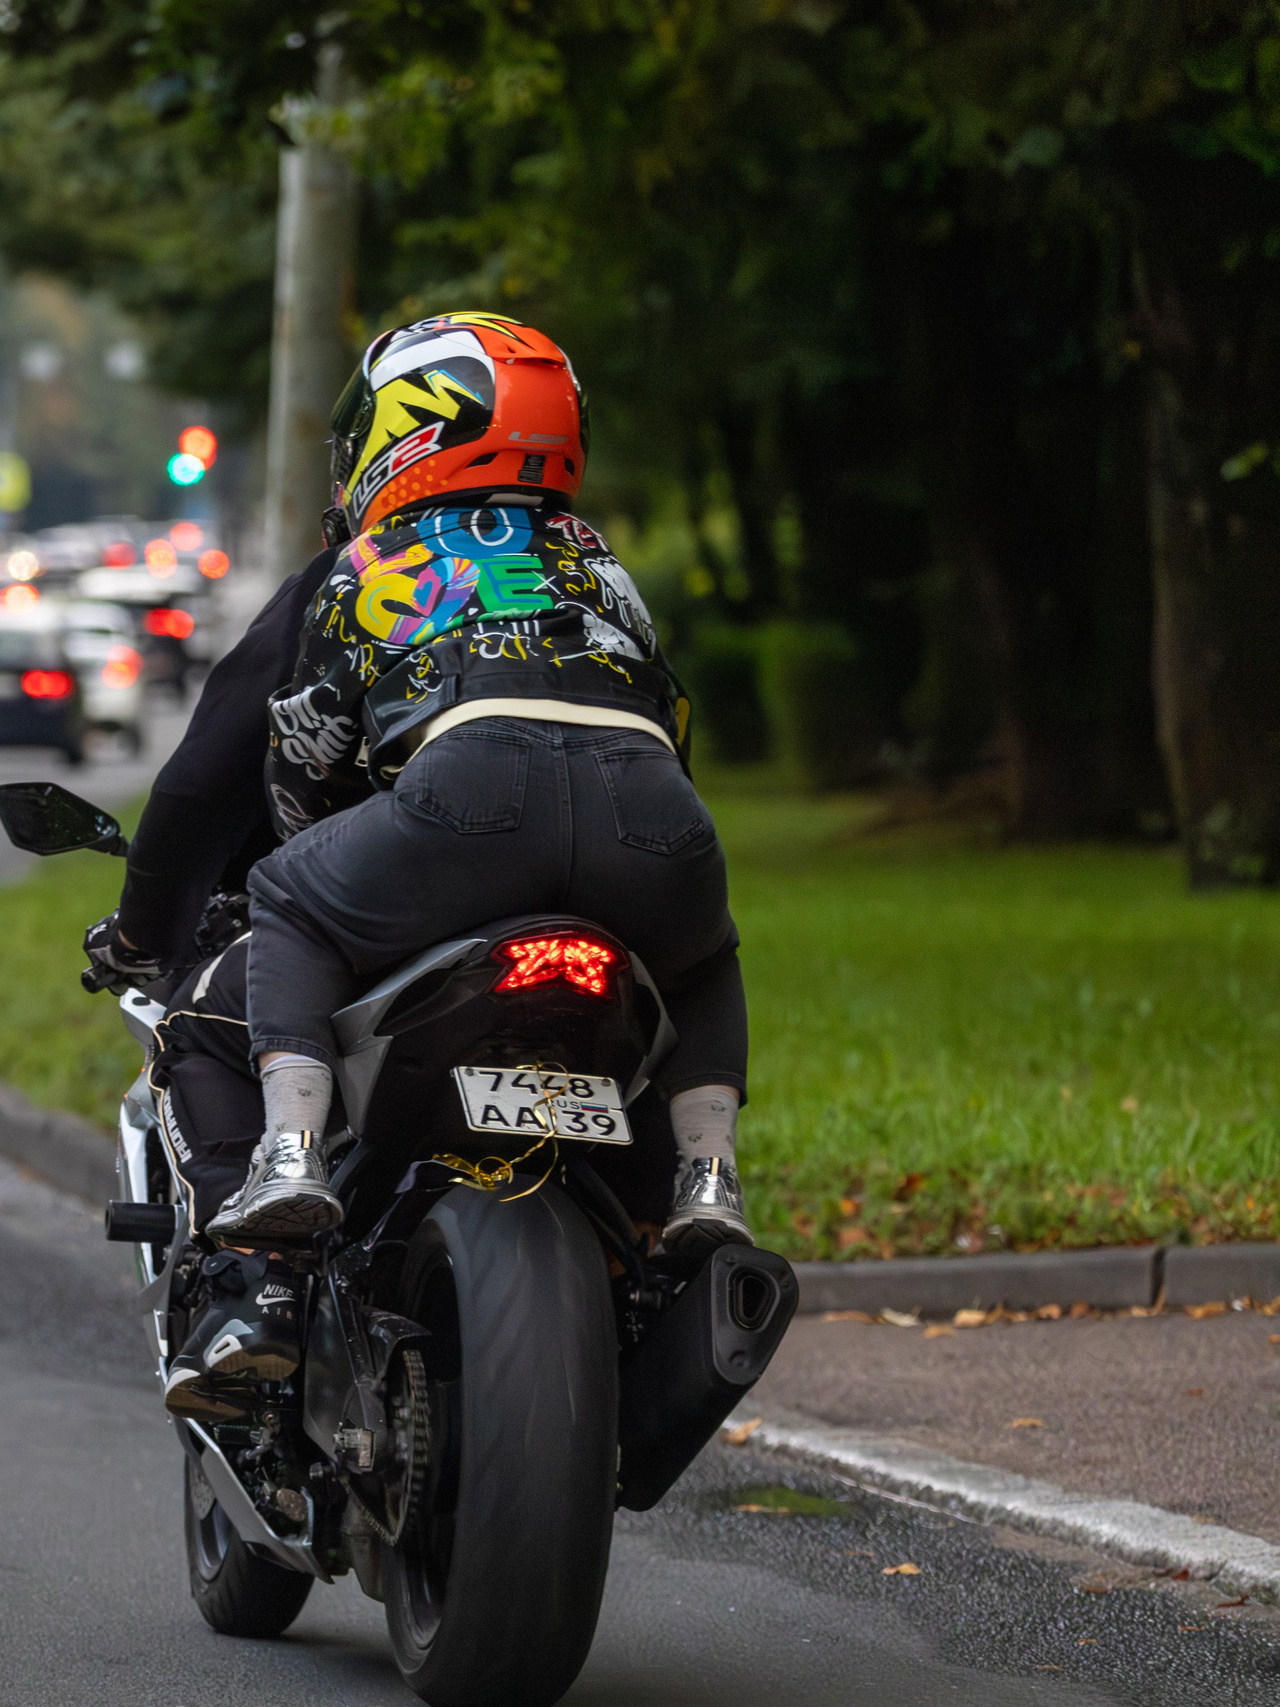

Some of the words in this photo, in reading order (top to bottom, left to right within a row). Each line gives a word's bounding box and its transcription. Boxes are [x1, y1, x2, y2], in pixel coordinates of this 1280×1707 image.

[479, 1071, 595, 1099] 7448
[481, 1104, 545, 1130] AA
[562, 1110, 616, 1136] 39
[263, 1283, 294, 1297] NIKE
[261, 1306, 293, 1320] AIR
